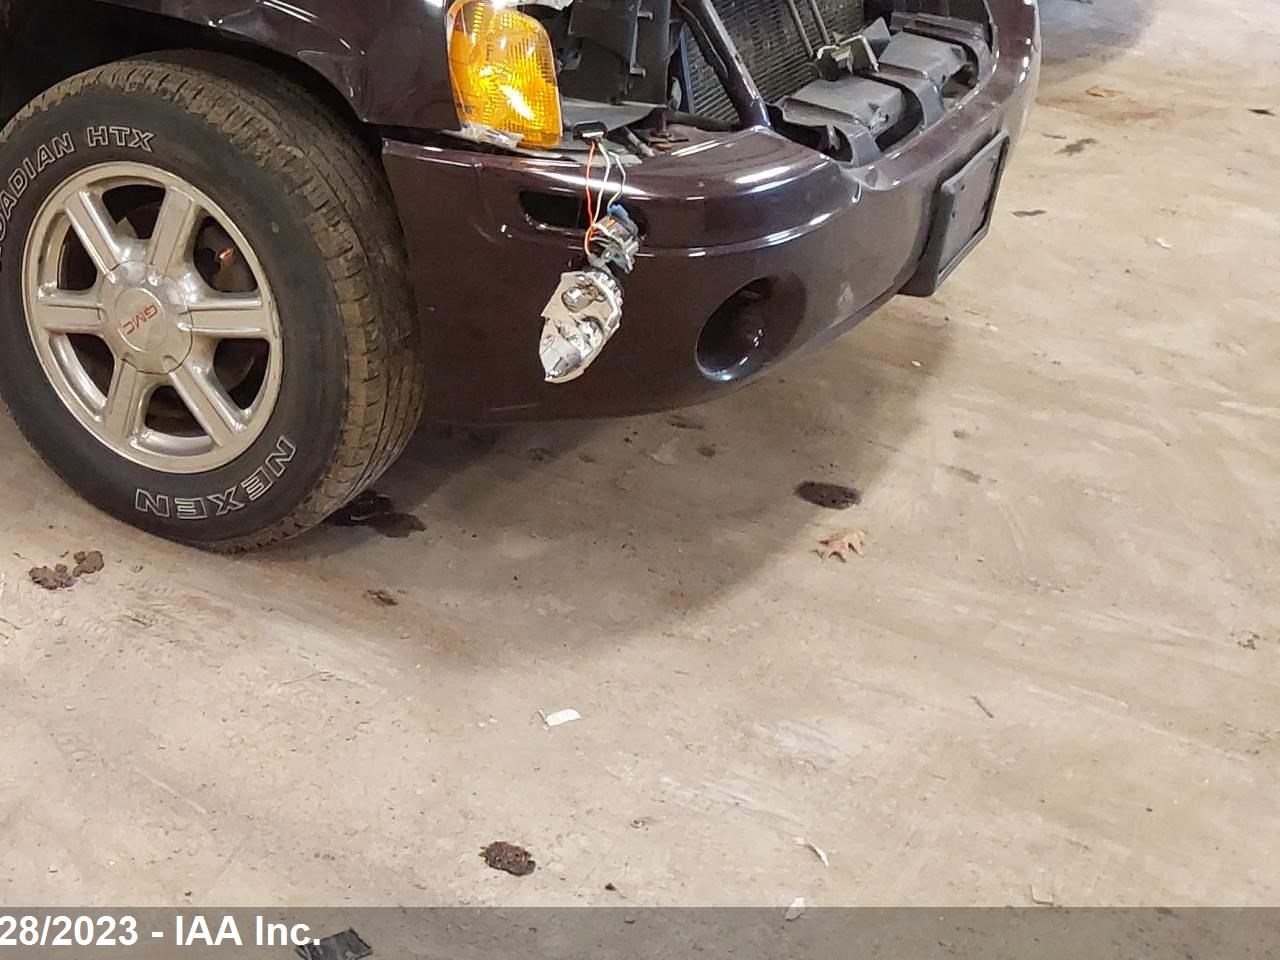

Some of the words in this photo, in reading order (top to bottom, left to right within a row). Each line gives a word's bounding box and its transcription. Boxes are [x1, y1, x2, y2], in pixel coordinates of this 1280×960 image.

[86, 125, 156, 153] HTX
[122, 303, 159, 336] GMC
[135, 435, 297, 520] NEXEN
